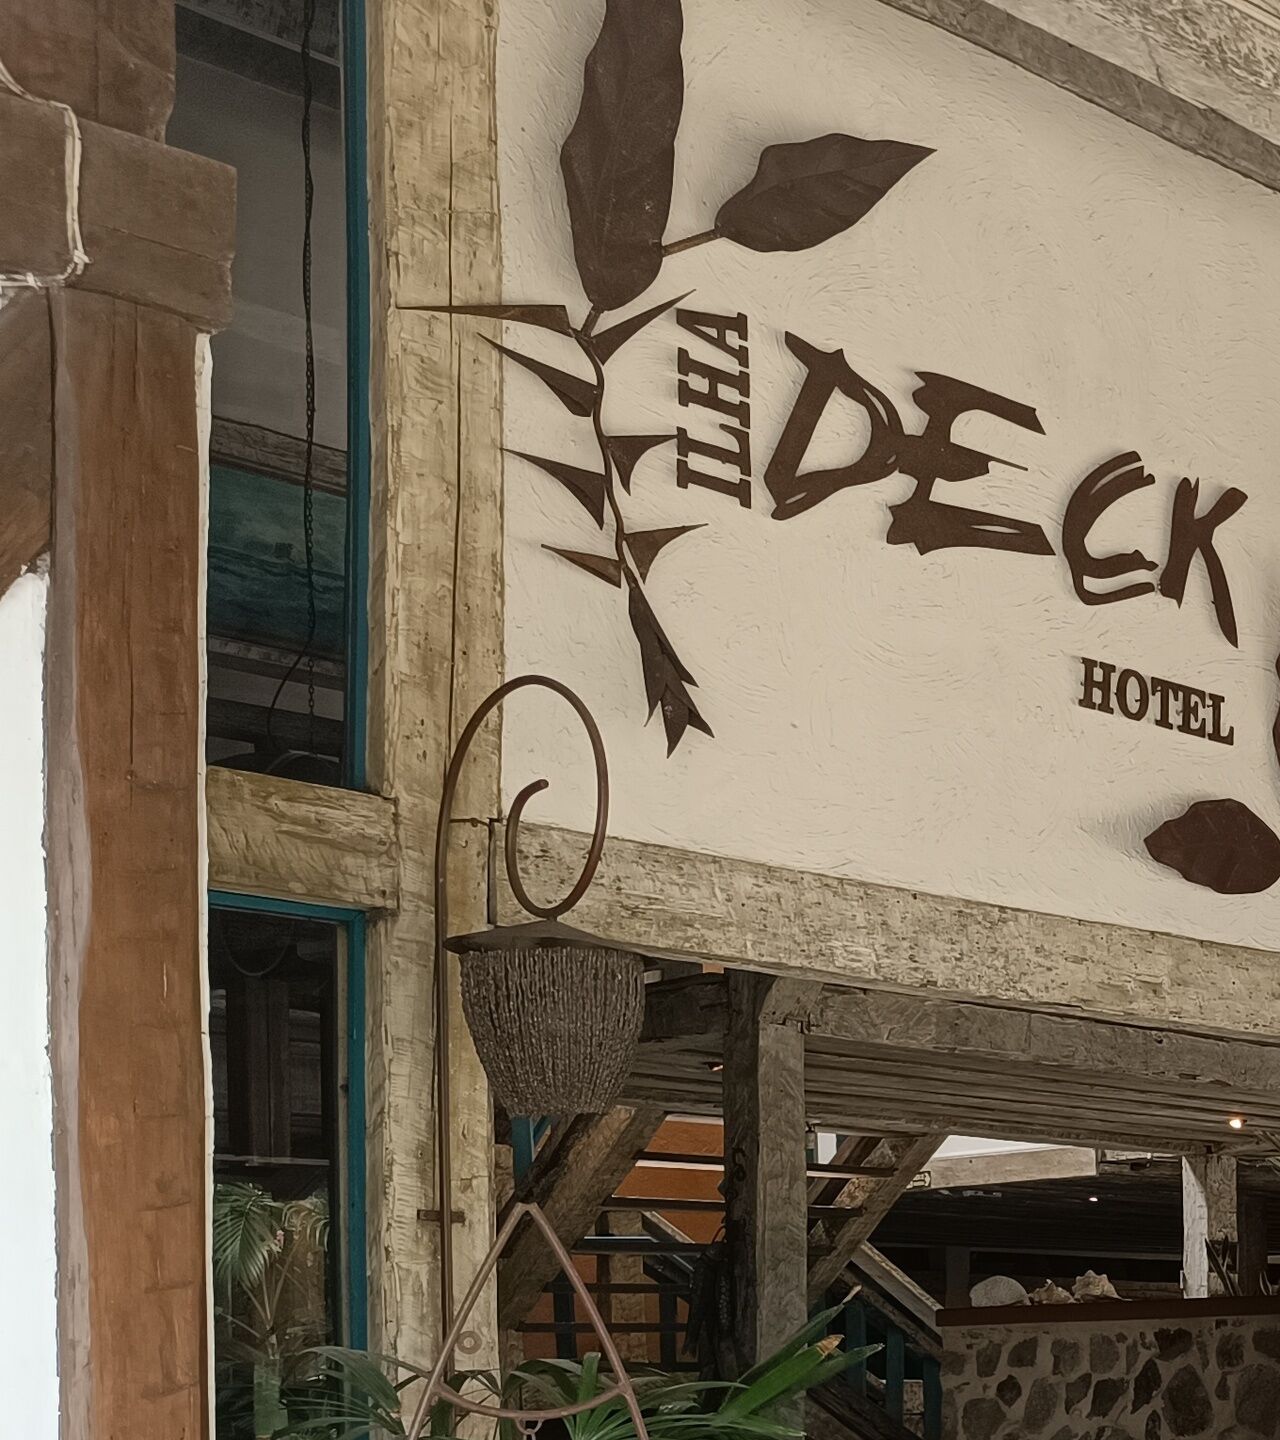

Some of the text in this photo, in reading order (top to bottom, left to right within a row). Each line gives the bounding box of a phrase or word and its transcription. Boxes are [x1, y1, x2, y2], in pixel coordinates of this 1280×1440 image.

[676, 310, 752, 508] ILHA
[763, 331, 1248, 649] DECK
[1078, 657, 1235, 746] HOTEL
